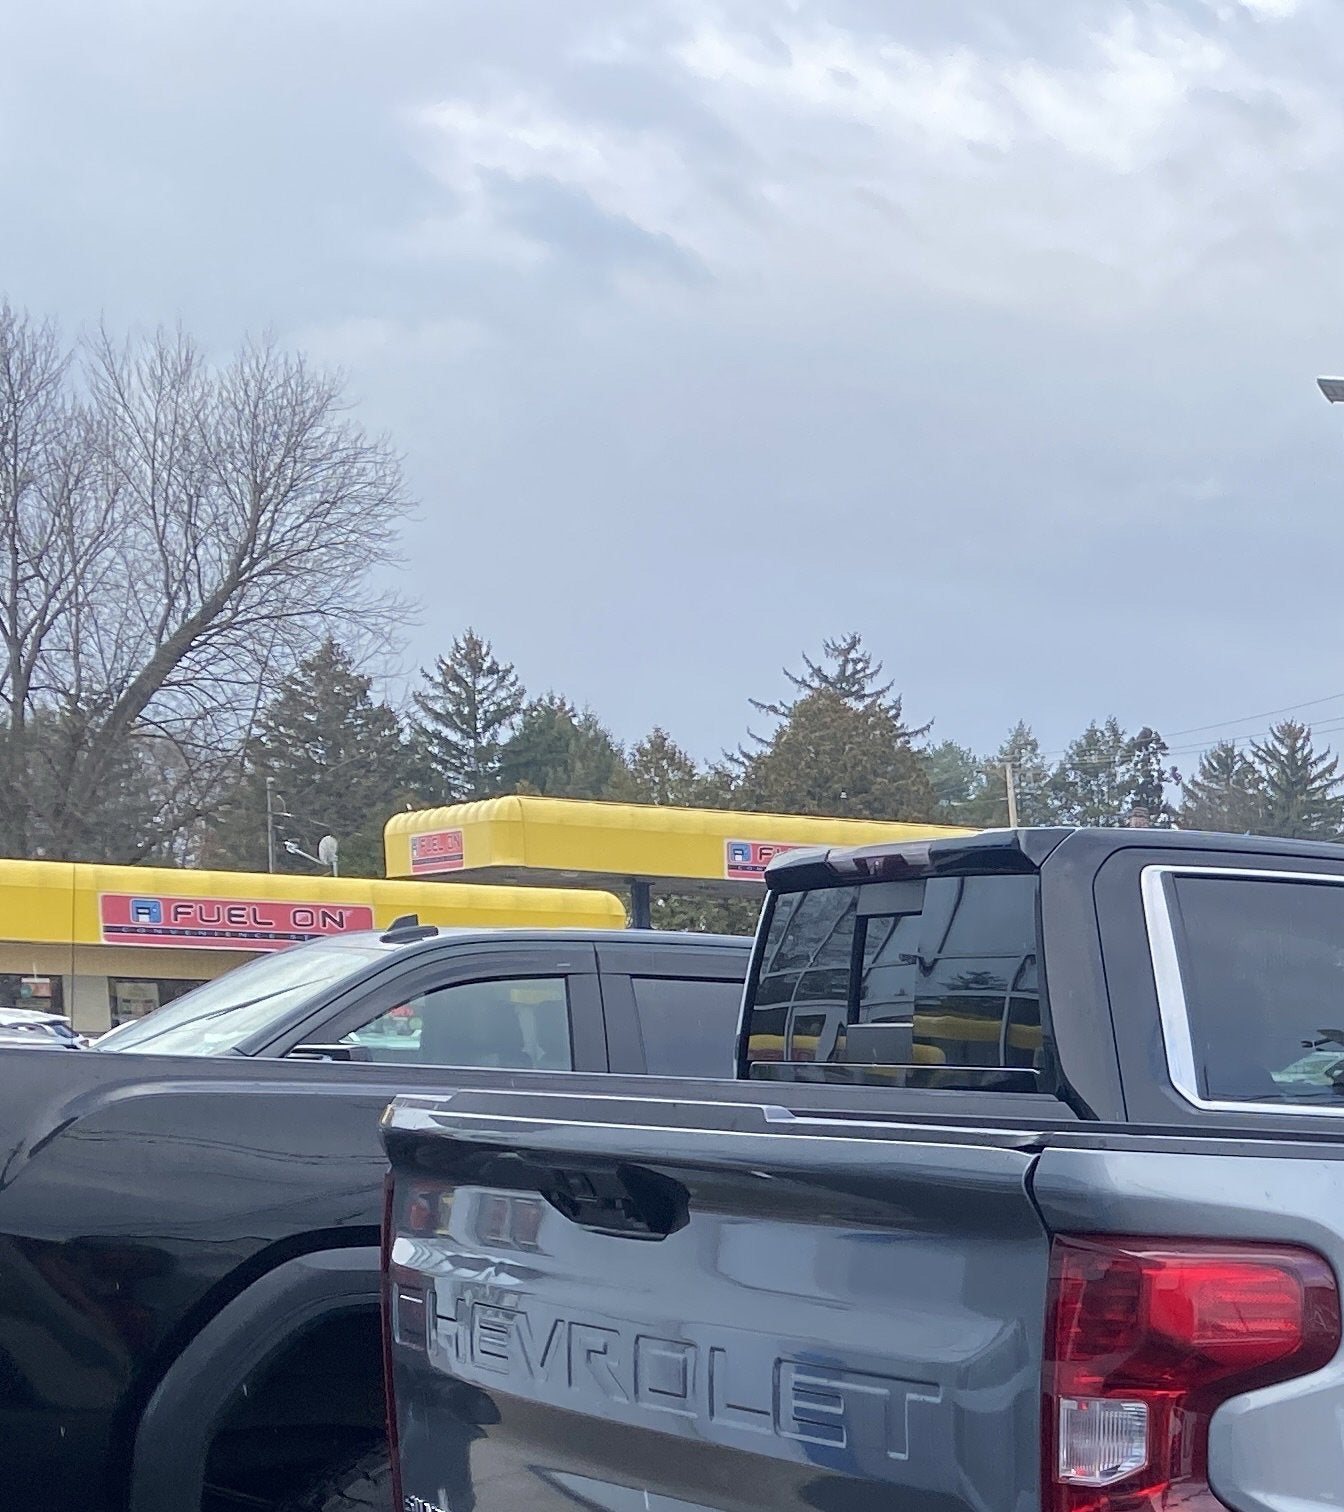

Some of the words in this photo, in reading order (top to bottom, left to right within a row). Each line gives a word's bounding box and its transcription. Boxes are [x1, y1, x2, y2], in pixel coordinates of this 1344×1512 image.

[172, 903, 274, 927] FUEL
[291, 909, 345, 929] ON
[121, 926, 277, 940] CONVENIENCE
[391, 1281, 944, 1461] CHEVROLET
